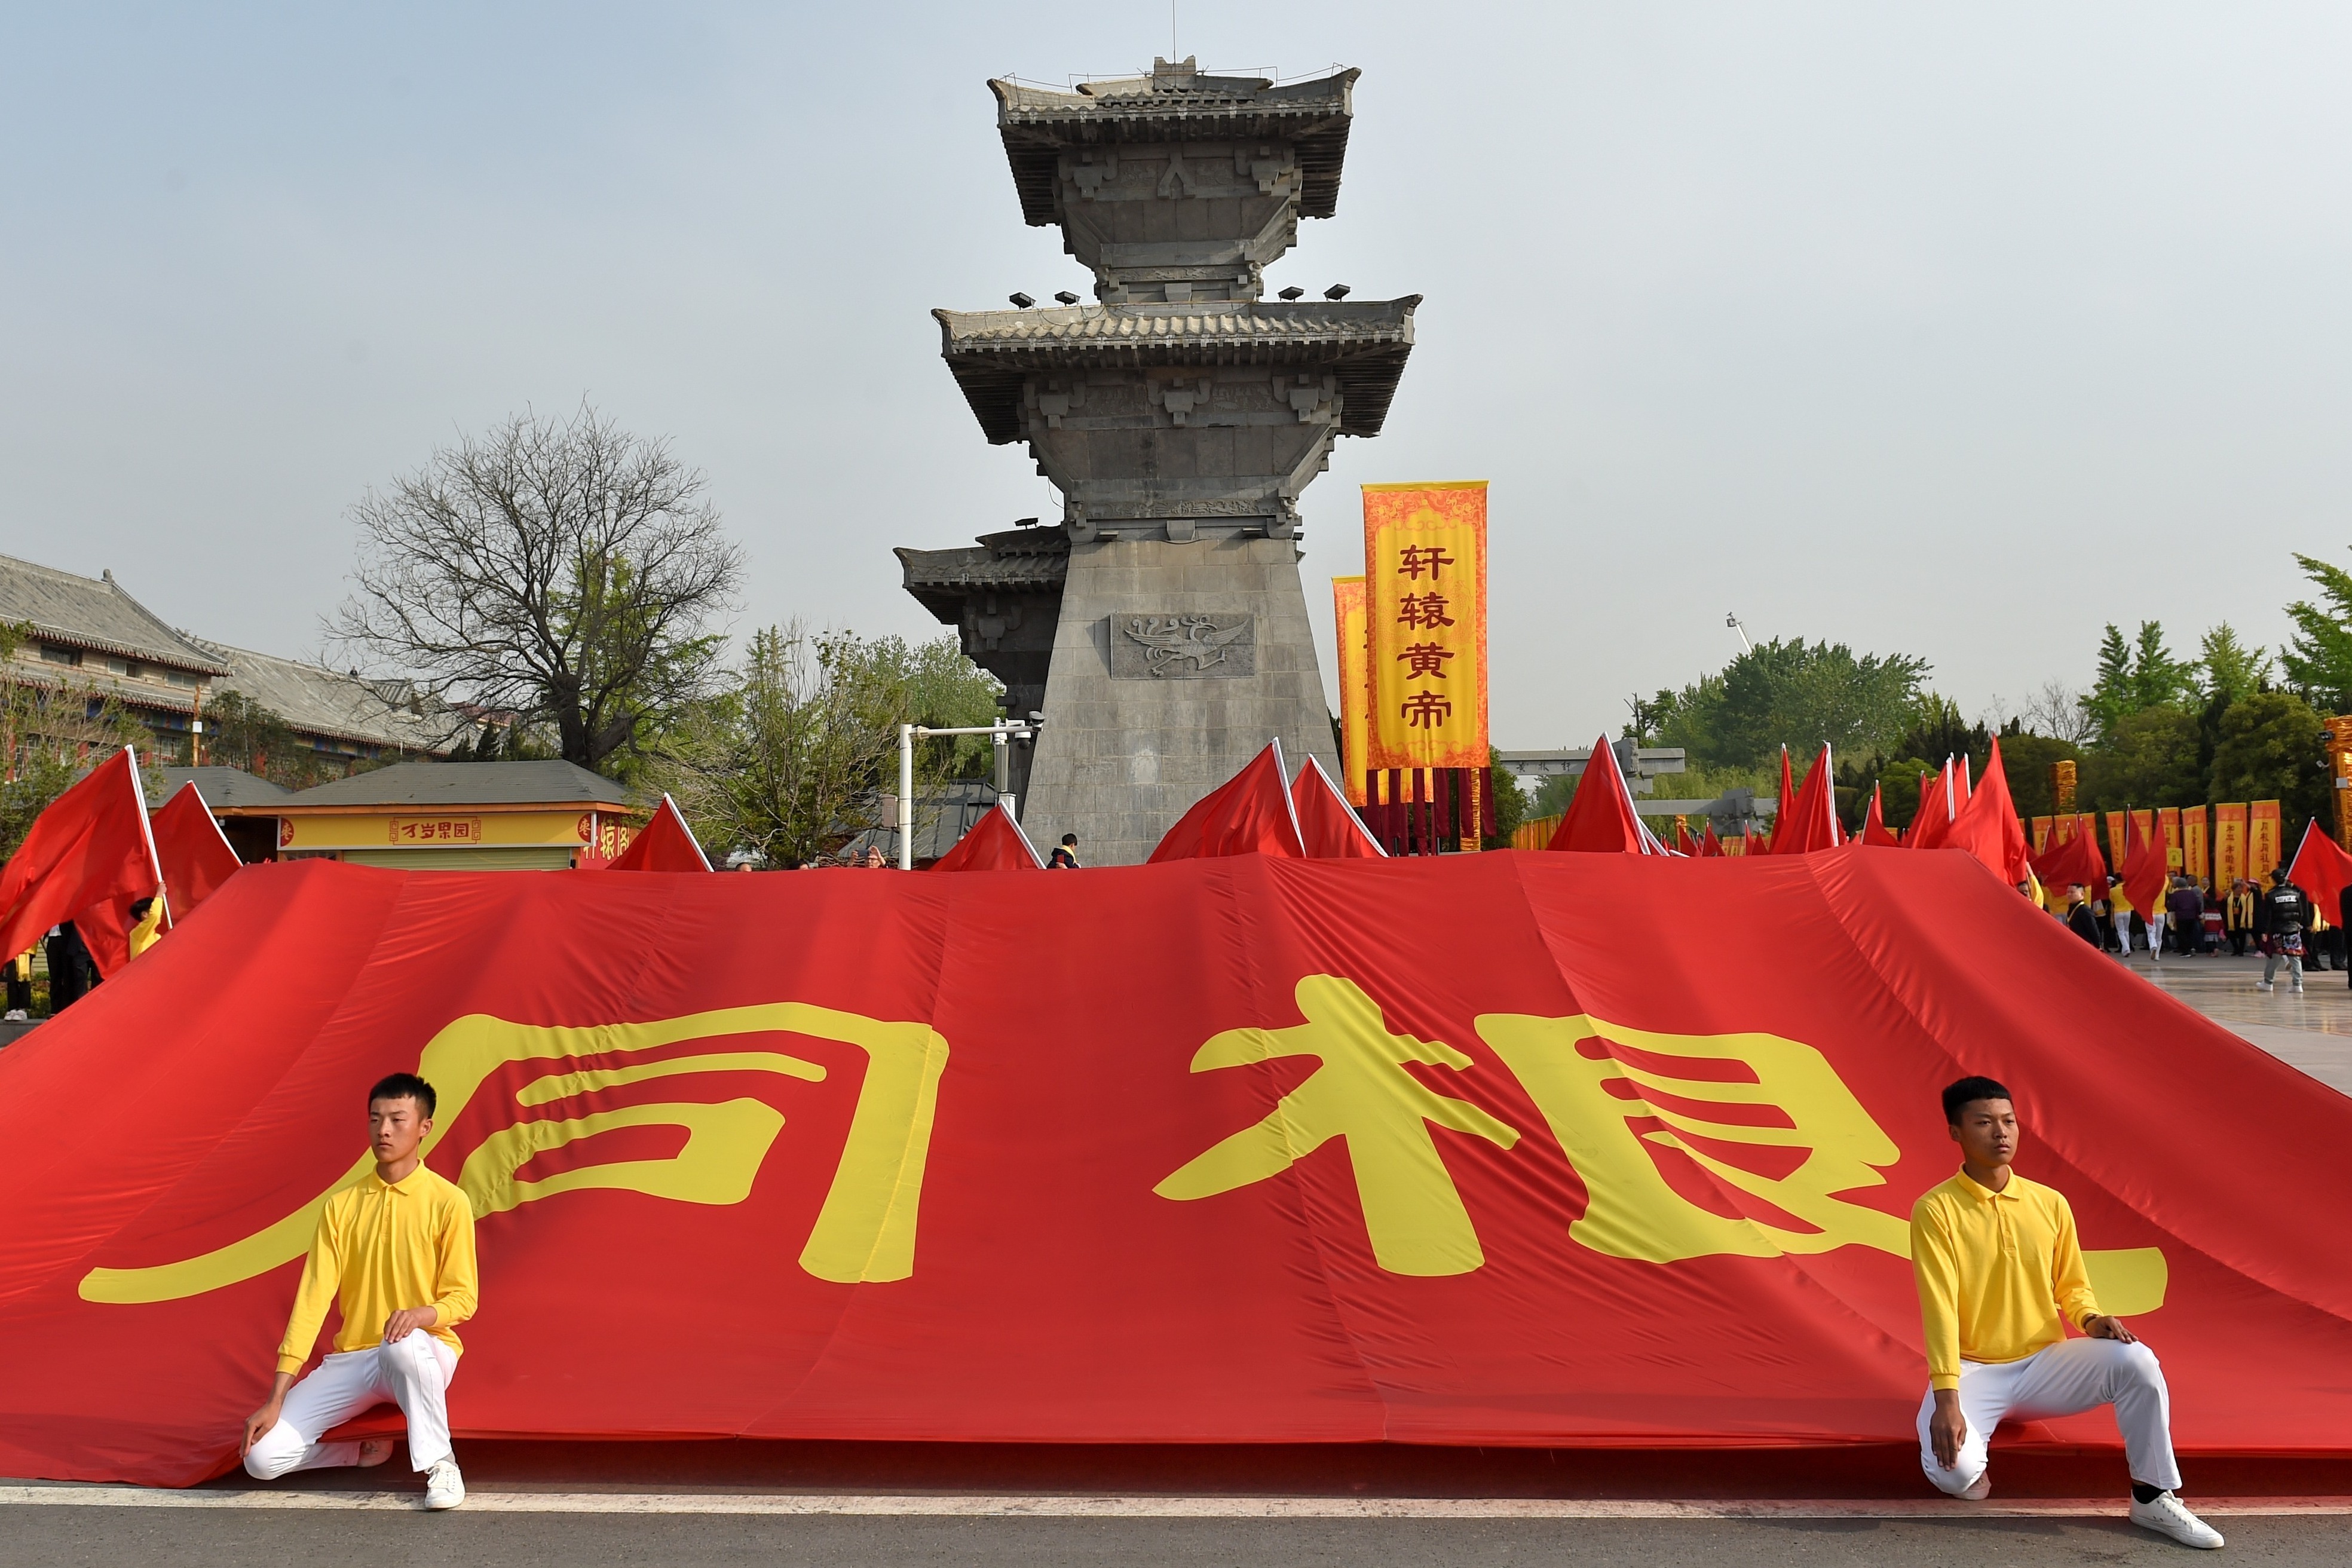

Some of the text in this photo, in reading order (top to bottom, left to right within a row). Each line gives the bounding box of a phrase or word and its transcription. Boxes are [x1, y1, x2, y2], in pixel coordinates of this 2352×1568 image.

[1396, 544, 1455, 729] 轩辕黄帝
[401, 822, 469, 839] 万岁果园
[578, 817, 591, 835] 枣
